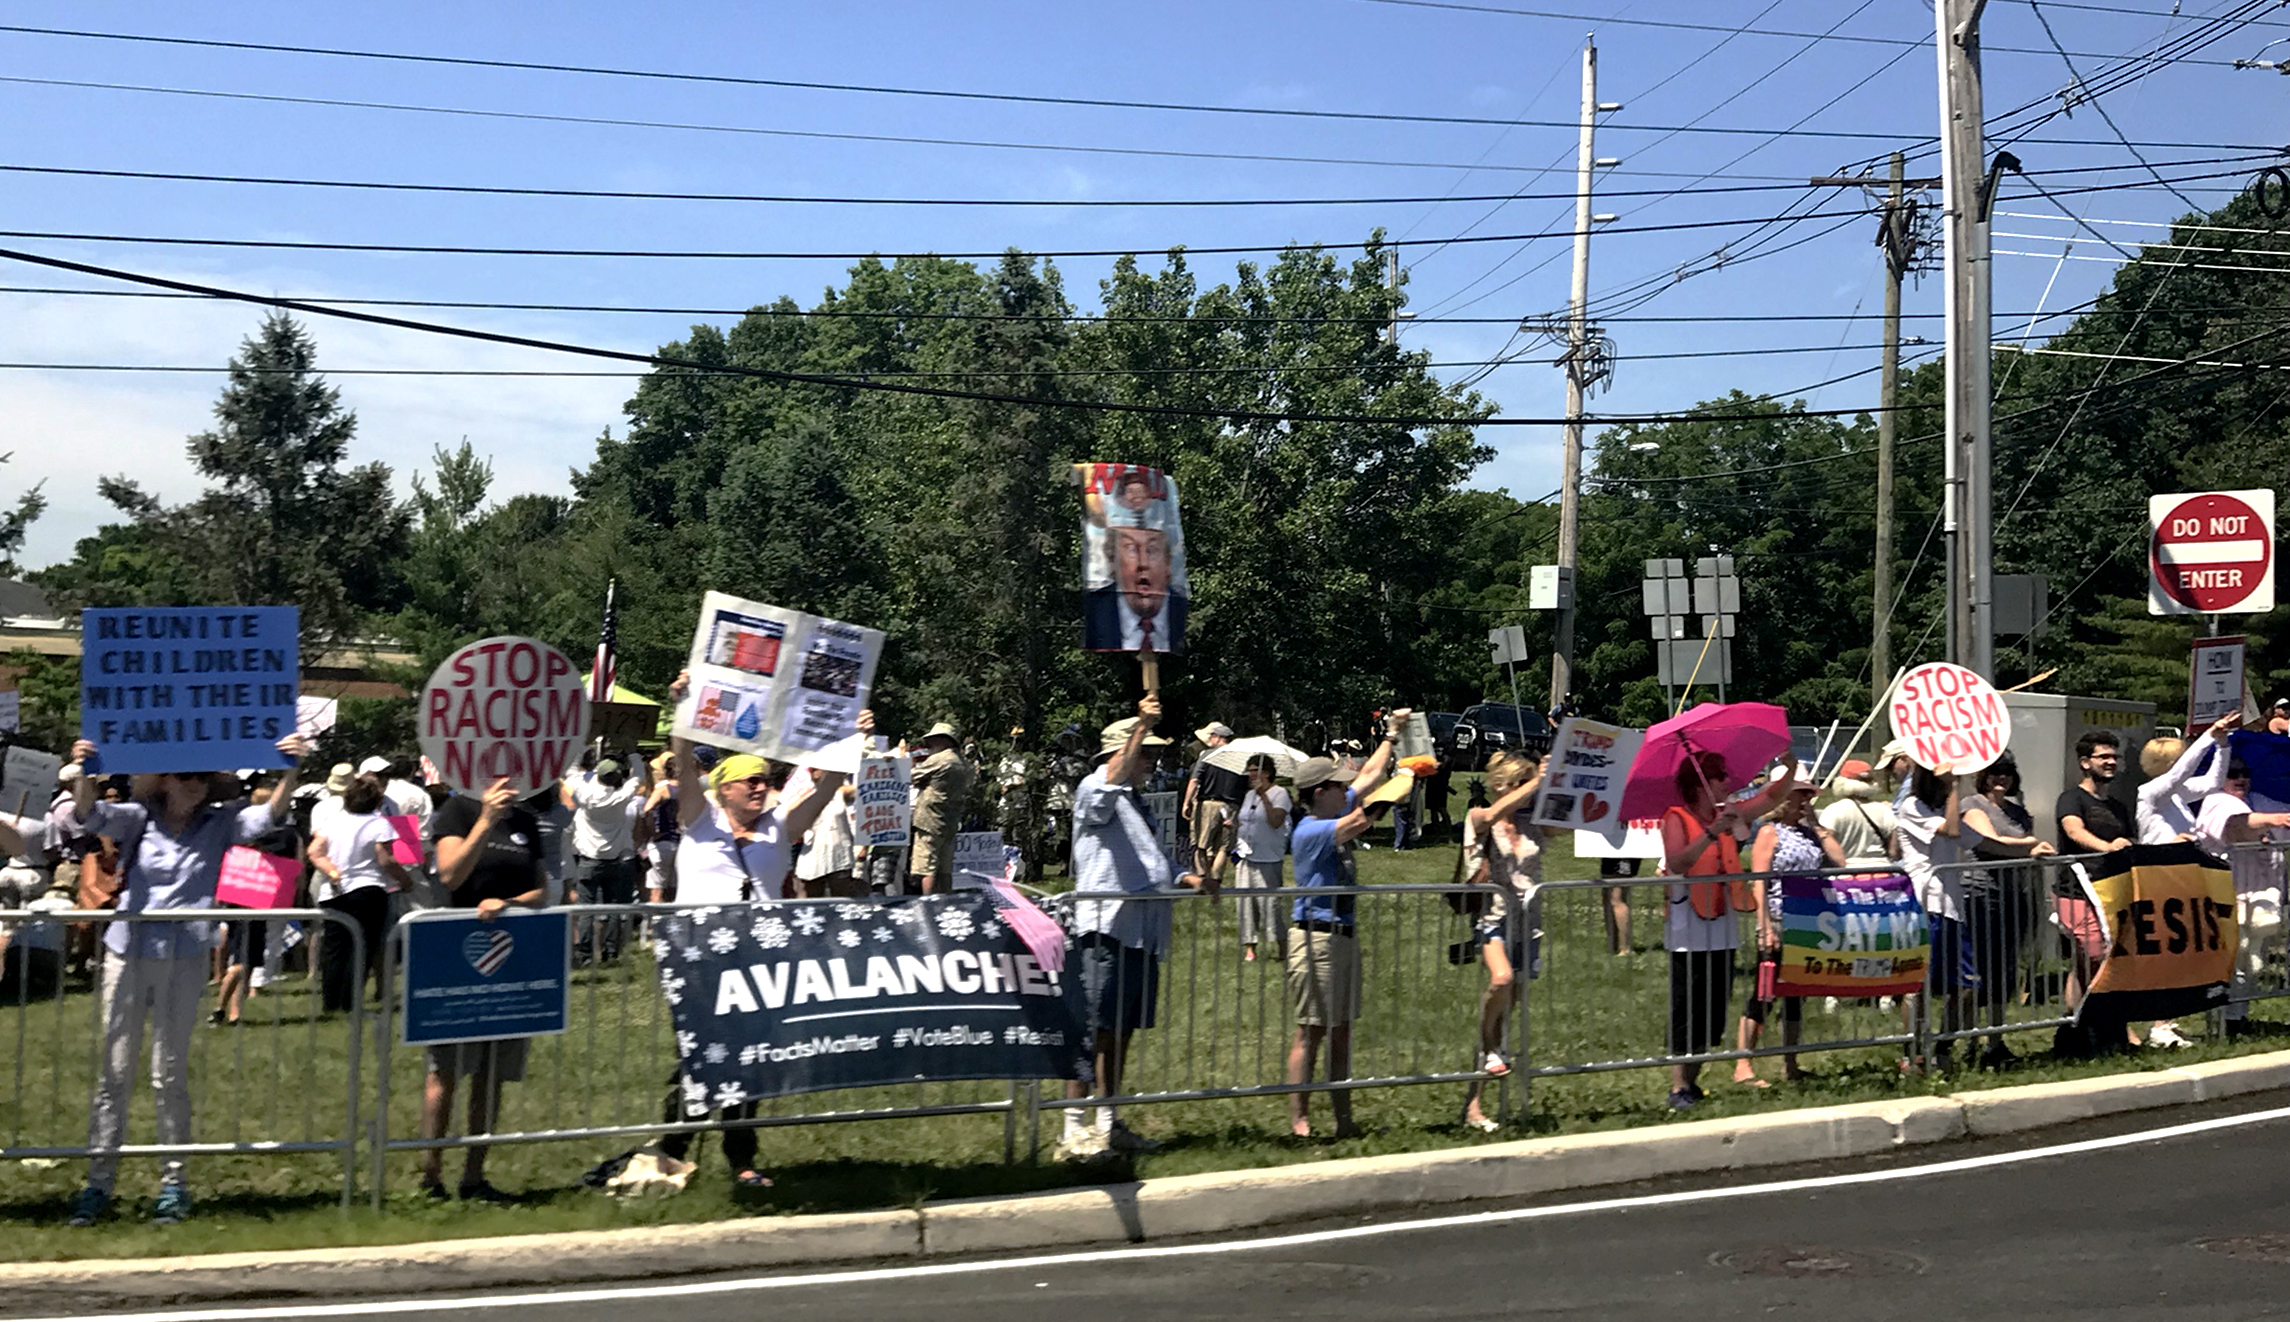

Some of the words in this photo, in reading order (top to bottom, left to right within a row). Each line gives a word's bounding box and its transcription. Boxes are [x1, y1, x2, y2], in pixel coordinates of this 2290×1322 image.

[2173, 517, 2201, 537] DO
[2209, 516, 2249, 536] NOT
[2179, 569, 2242, 589] ENTER
[98, 614, 260, 640] REUNITE
[100, 648, 285, 675] CHILDREN
[451, 642, 569, 689] STOP
[86, 683, 174, 710] WITH
[1902, 666, 1979, 701] STOP
[100, 716, 280, 744] FAMILIES
[427, 688, 583, 738] RACISM
[1893, 693, 2003, 737] RACISM
[1914, 726, 2001, 765] NOW
[444, 740, 572, 790] NOW
[1817, 910, 1881, 952] SAY
[1888, 911, 1921, 950] NO
[713, 948, 1064, 1017] AVALANCHE!
[1804, 956, 1823, 975] To
[1827, 957, 1853, 976] The
[737, 1033, 882, 1066] #FactsMatter
[891, 1024, 995, 1049] #VoteBlue
